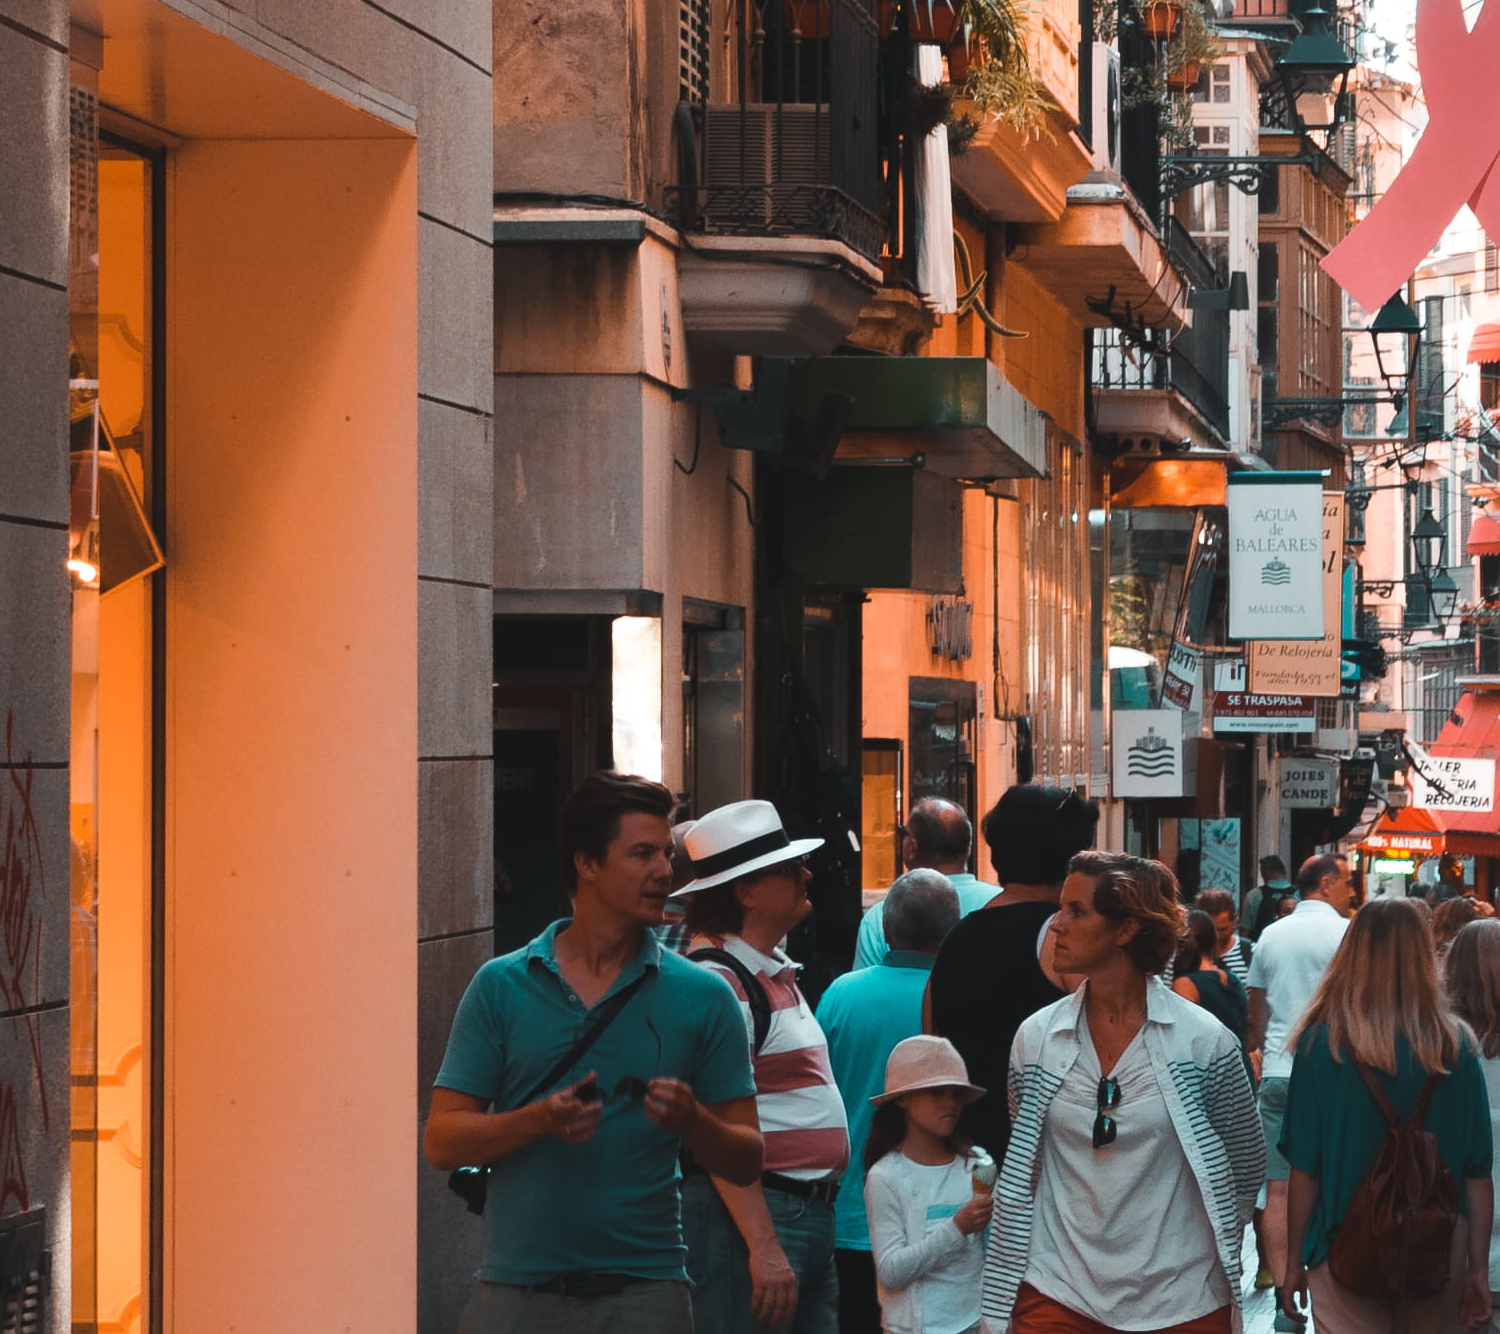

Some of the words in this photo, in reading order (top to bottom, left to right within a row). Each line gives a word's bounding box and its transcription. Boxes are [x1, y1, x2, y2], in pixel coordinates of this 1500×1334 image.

[1253, 508, 1298, 522] AGUA
[1269, 524, 1284, 537] de
[1235, 538, 1319, 553] BALEARES
[1247, 604, 1306, 615] MALLORCA
[1258, 643, 1276, 656] De
[1279, 643, 1334, 661] Relojería
[1227, 695, 1242, 706] SE
[1243, 695, 1303, 707] TRASPASA
[1285, 770, 1325, 782] JOIES
[1390, 837, 1433, 850] NATURAL
